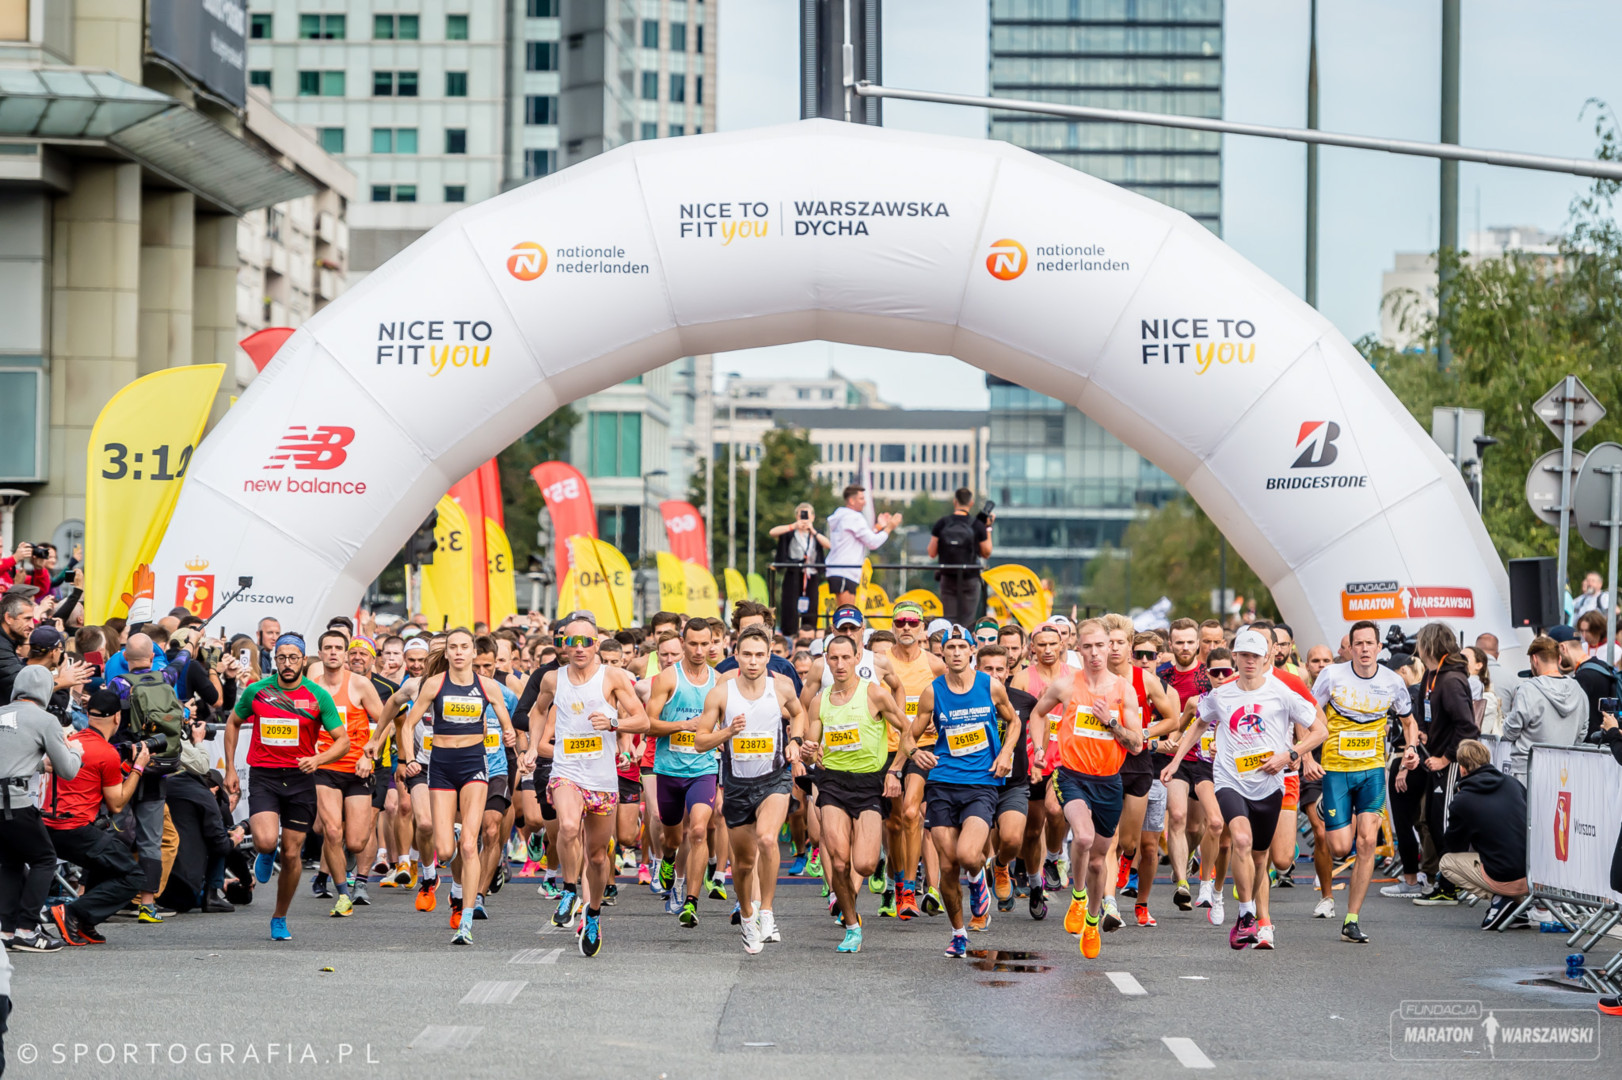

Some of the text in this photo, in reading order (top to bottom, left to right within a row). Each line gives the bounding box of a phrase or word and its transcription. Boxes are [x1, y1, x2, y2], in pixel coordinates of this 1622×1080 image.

[680, 202, 769, 218] NICE TO
[794, 201, 950, 217] WARSZAWSKA
[680, 220, 768, 246] FIT you
[794, 220, 869, 236] DYCHA
[556, 245, 625, 258] nationale
[1036, 243, 1105, 256] nationale
[556, 261, 649, 274] nederlanden
[1036, 258, 1130, 272] nederlanden
[378, 320, 492, 342] NICE TO
[1141, 318, 1256, 339] NICE TO
[376, 344, 491, 377] FIT you
[1142, 342, 1256, 375] FIT you
[243, 477, 367, 494] new balance
[1266, 475, 1368, 490] BRIDGESTONE
[1349, 582, 1397, 592] FUNDACJA
[221, 590, 294, 604] Warszawa
[1349, 597, 1472, 611] MARATON WARSZAWSKI
[450, 703, 475, 713] 25599
[266, 726, 292, 735] 20929
[830, 731, 853, 742] 25542
[569, 739, 596, 750] 23924
[677, 733, 696, 743] 2613
[740, 740, 767, 749] 23873
[954, 732, 980, 745] 26185
[1346, 738, 1370, 748] 25259
